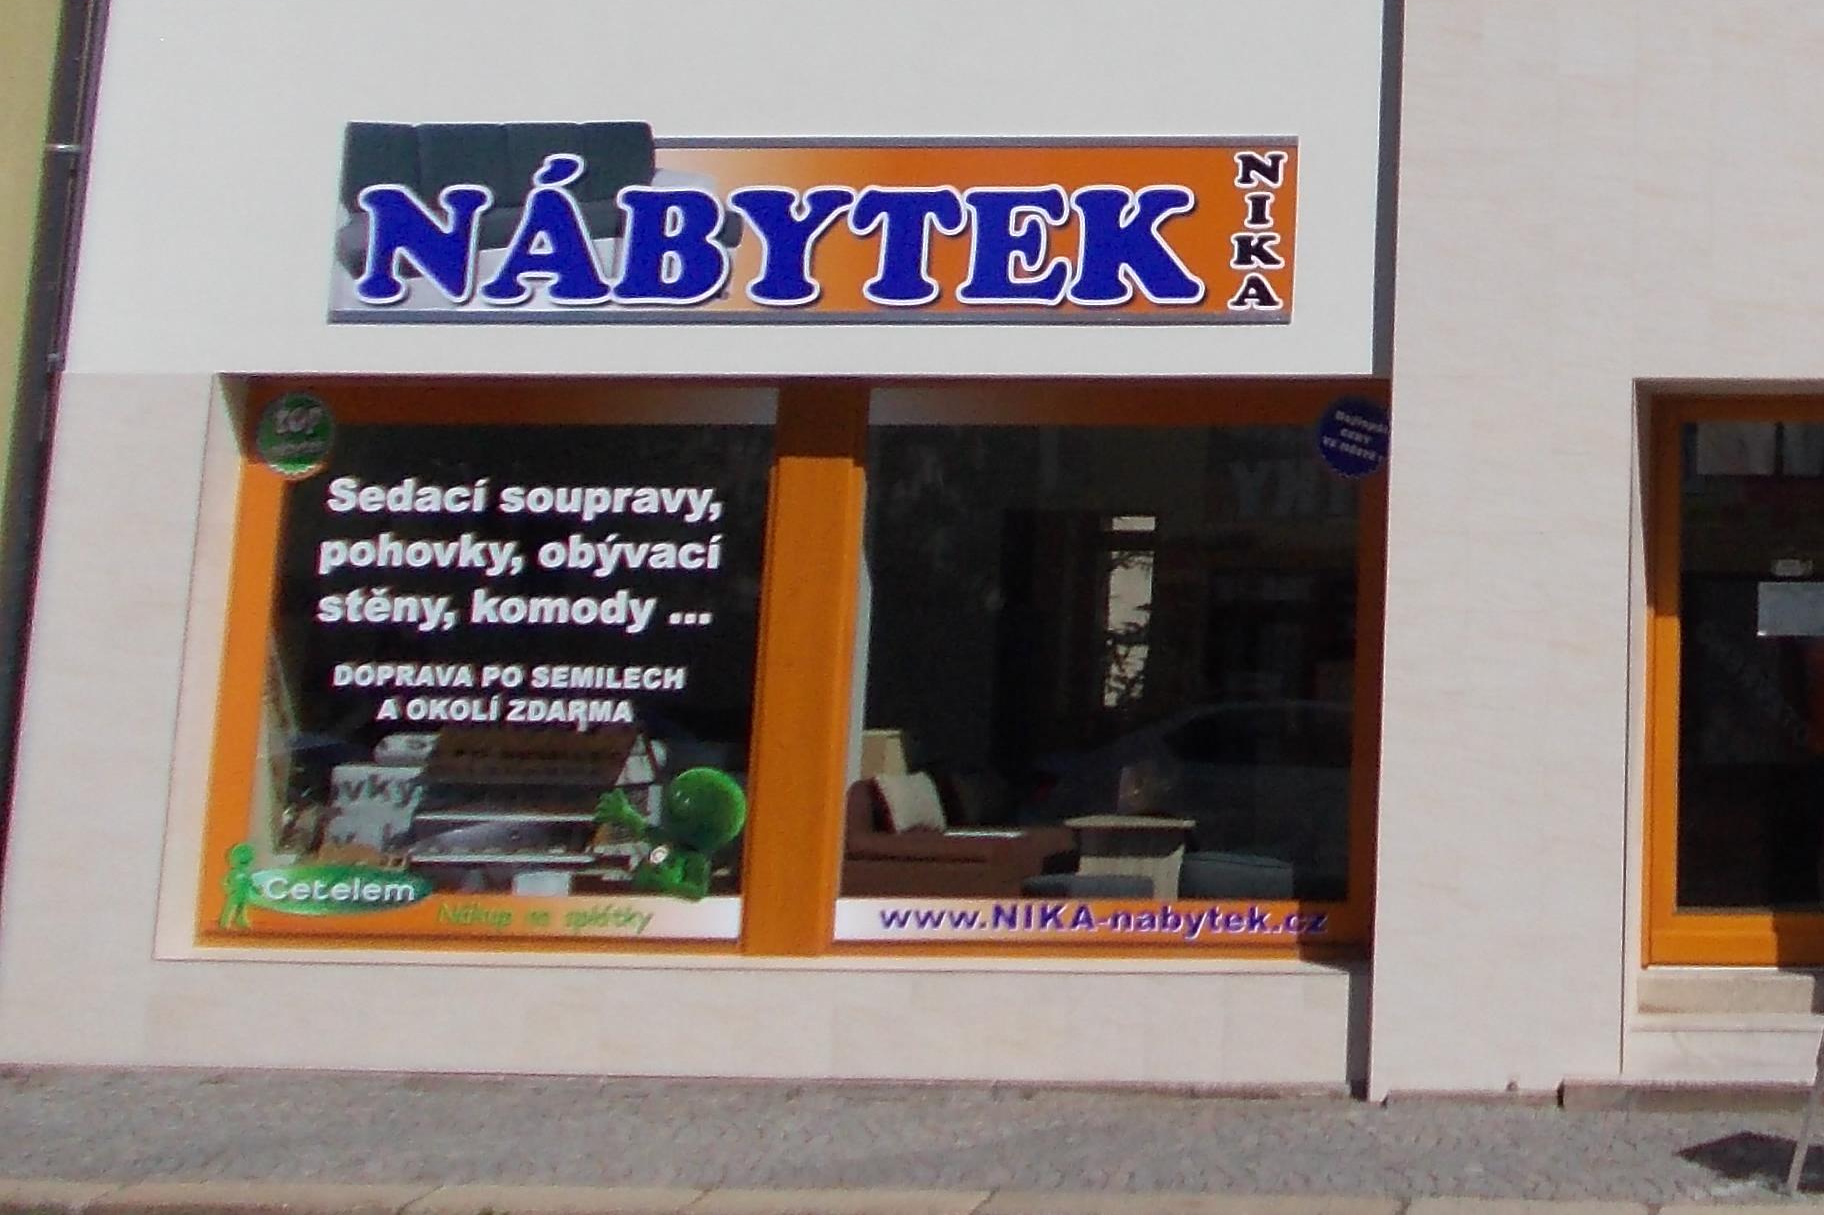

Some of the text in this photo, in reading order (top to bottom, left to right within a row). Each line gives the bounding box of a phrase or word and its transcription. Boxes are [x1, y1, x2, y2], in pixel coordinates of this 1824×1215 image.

[356, 153, 1205, 305] NÁBYTEK
[1228, 151, 1288, 311] NIKA
[327, 477, 723, 522] Sedací soupravy,
[318, 533, 722, 576] pohovky, obývací
[316, 589, 457, 630] stěny,
[472, 589, 656, 631] komody
[333, 664, 686, 691] DOPRAVA PO SEMILECH
[377, 694, 633, 725] A OKOLÍ ZDARMA
[263, 877, 416, 902] Cetelem
[879, 902, 1329, 940] www.NIKA-nabytek.cz
